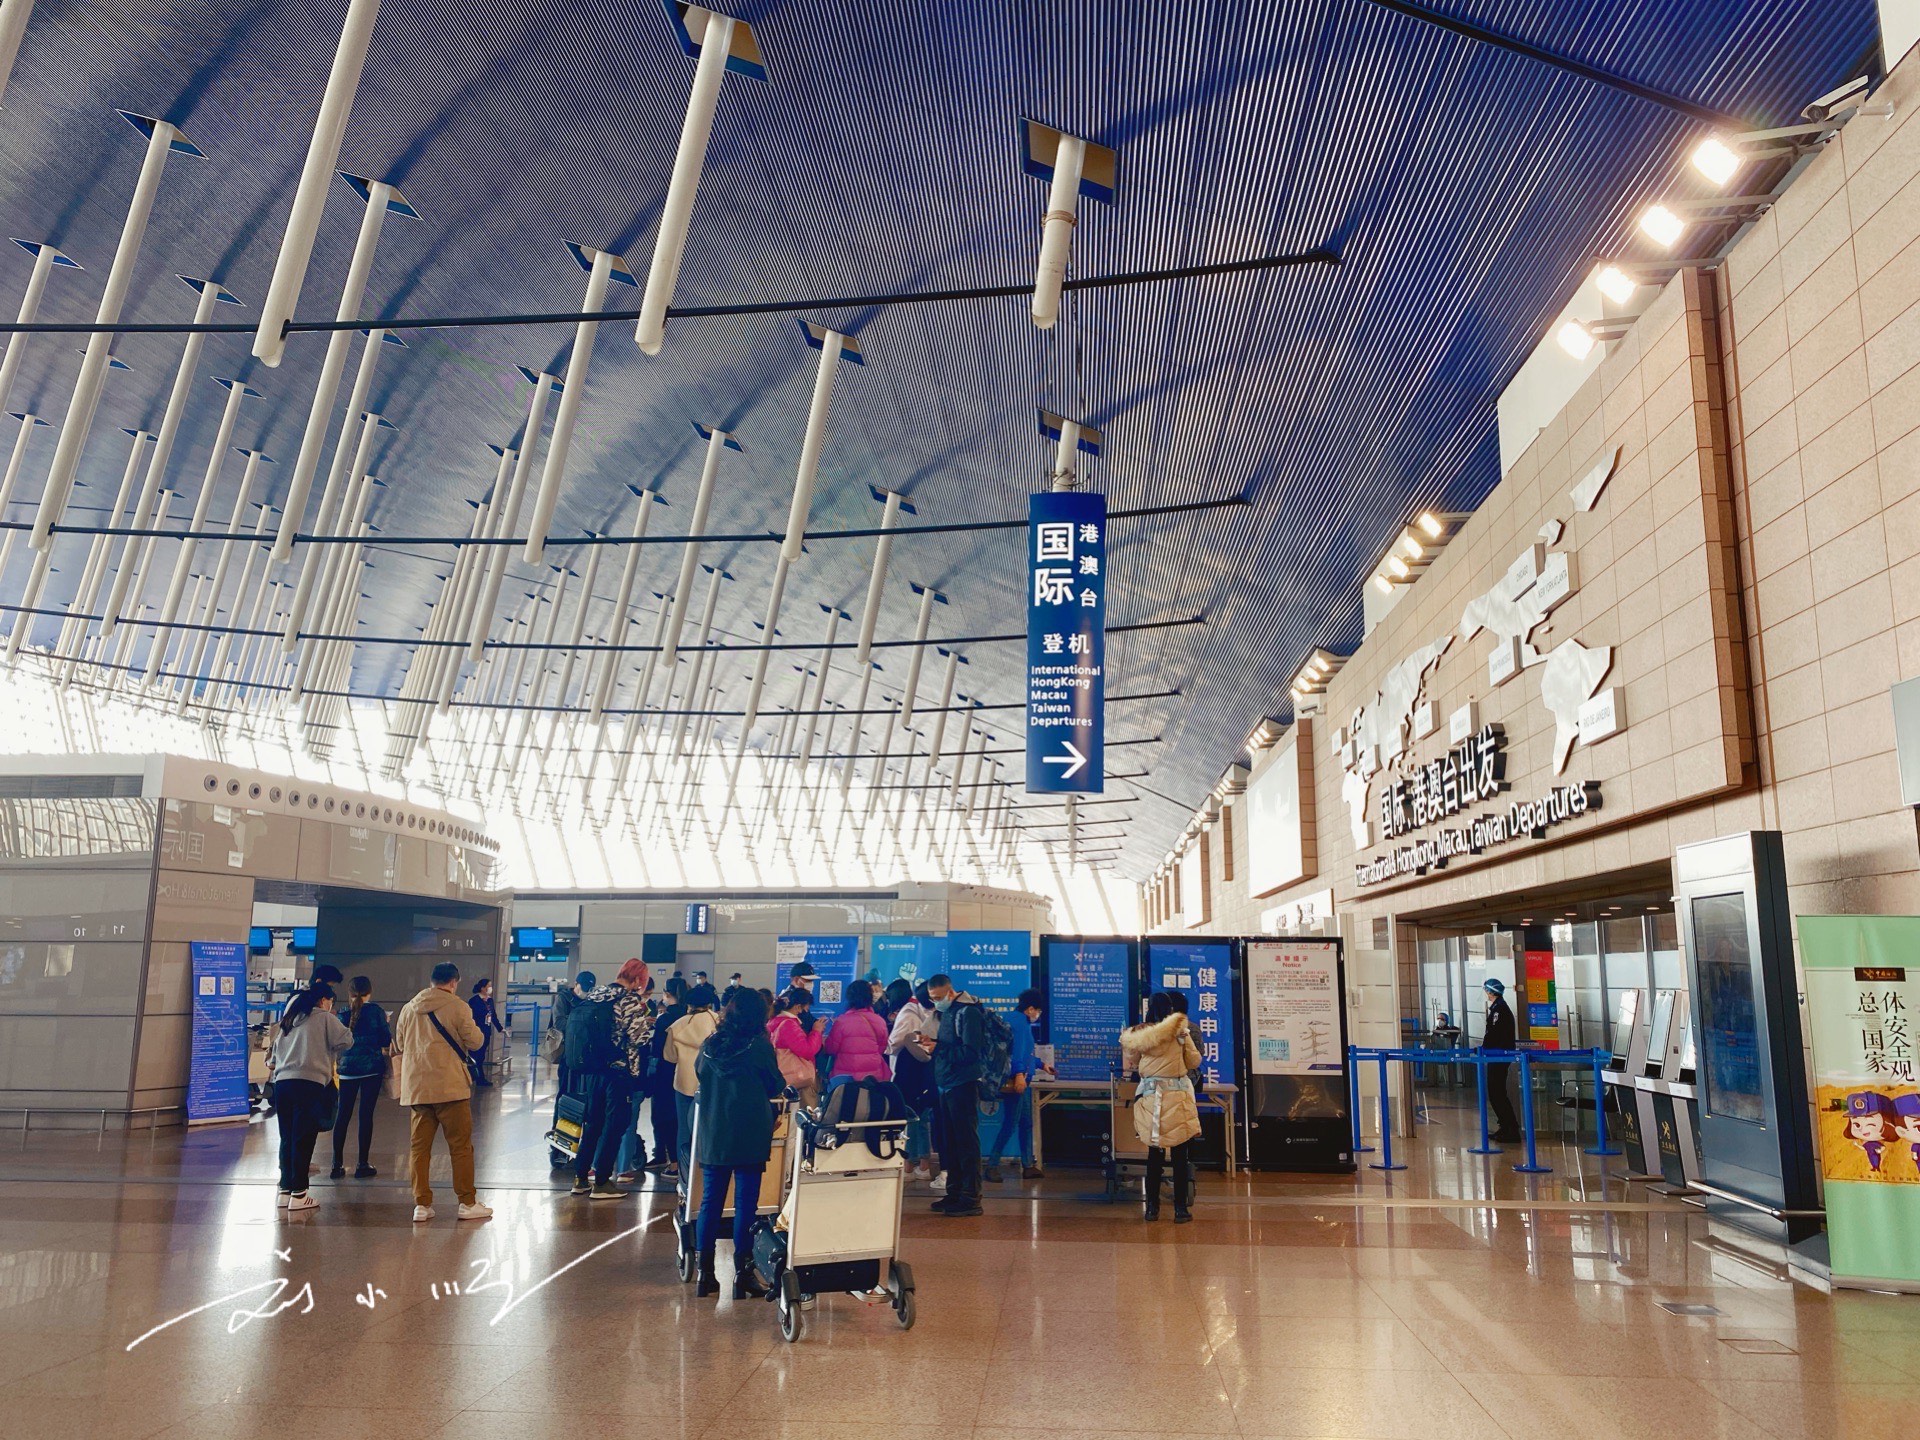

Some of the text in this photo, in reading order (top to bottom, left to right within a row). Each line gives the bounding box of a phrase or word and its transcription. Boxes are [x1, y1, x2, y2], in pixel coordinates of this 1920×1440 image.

[1034, 522, 1075, 607] 国际
[1079, 523, 1099, 607] 港澳台
[1043, 634, 1090, 654] 登机
[1031, 665, 1101, 676] International
[1031, 677, 1090, 690] HongKong
[1031, 690, 1068, 701] Macau
[1031, 703, 1071, 713] Taiwan
[1030, 716, 1093, 728] Departures
[1510, 781, 1588, 839] Departures
[1197, 967, 1221, 1089] 健康申明卡
